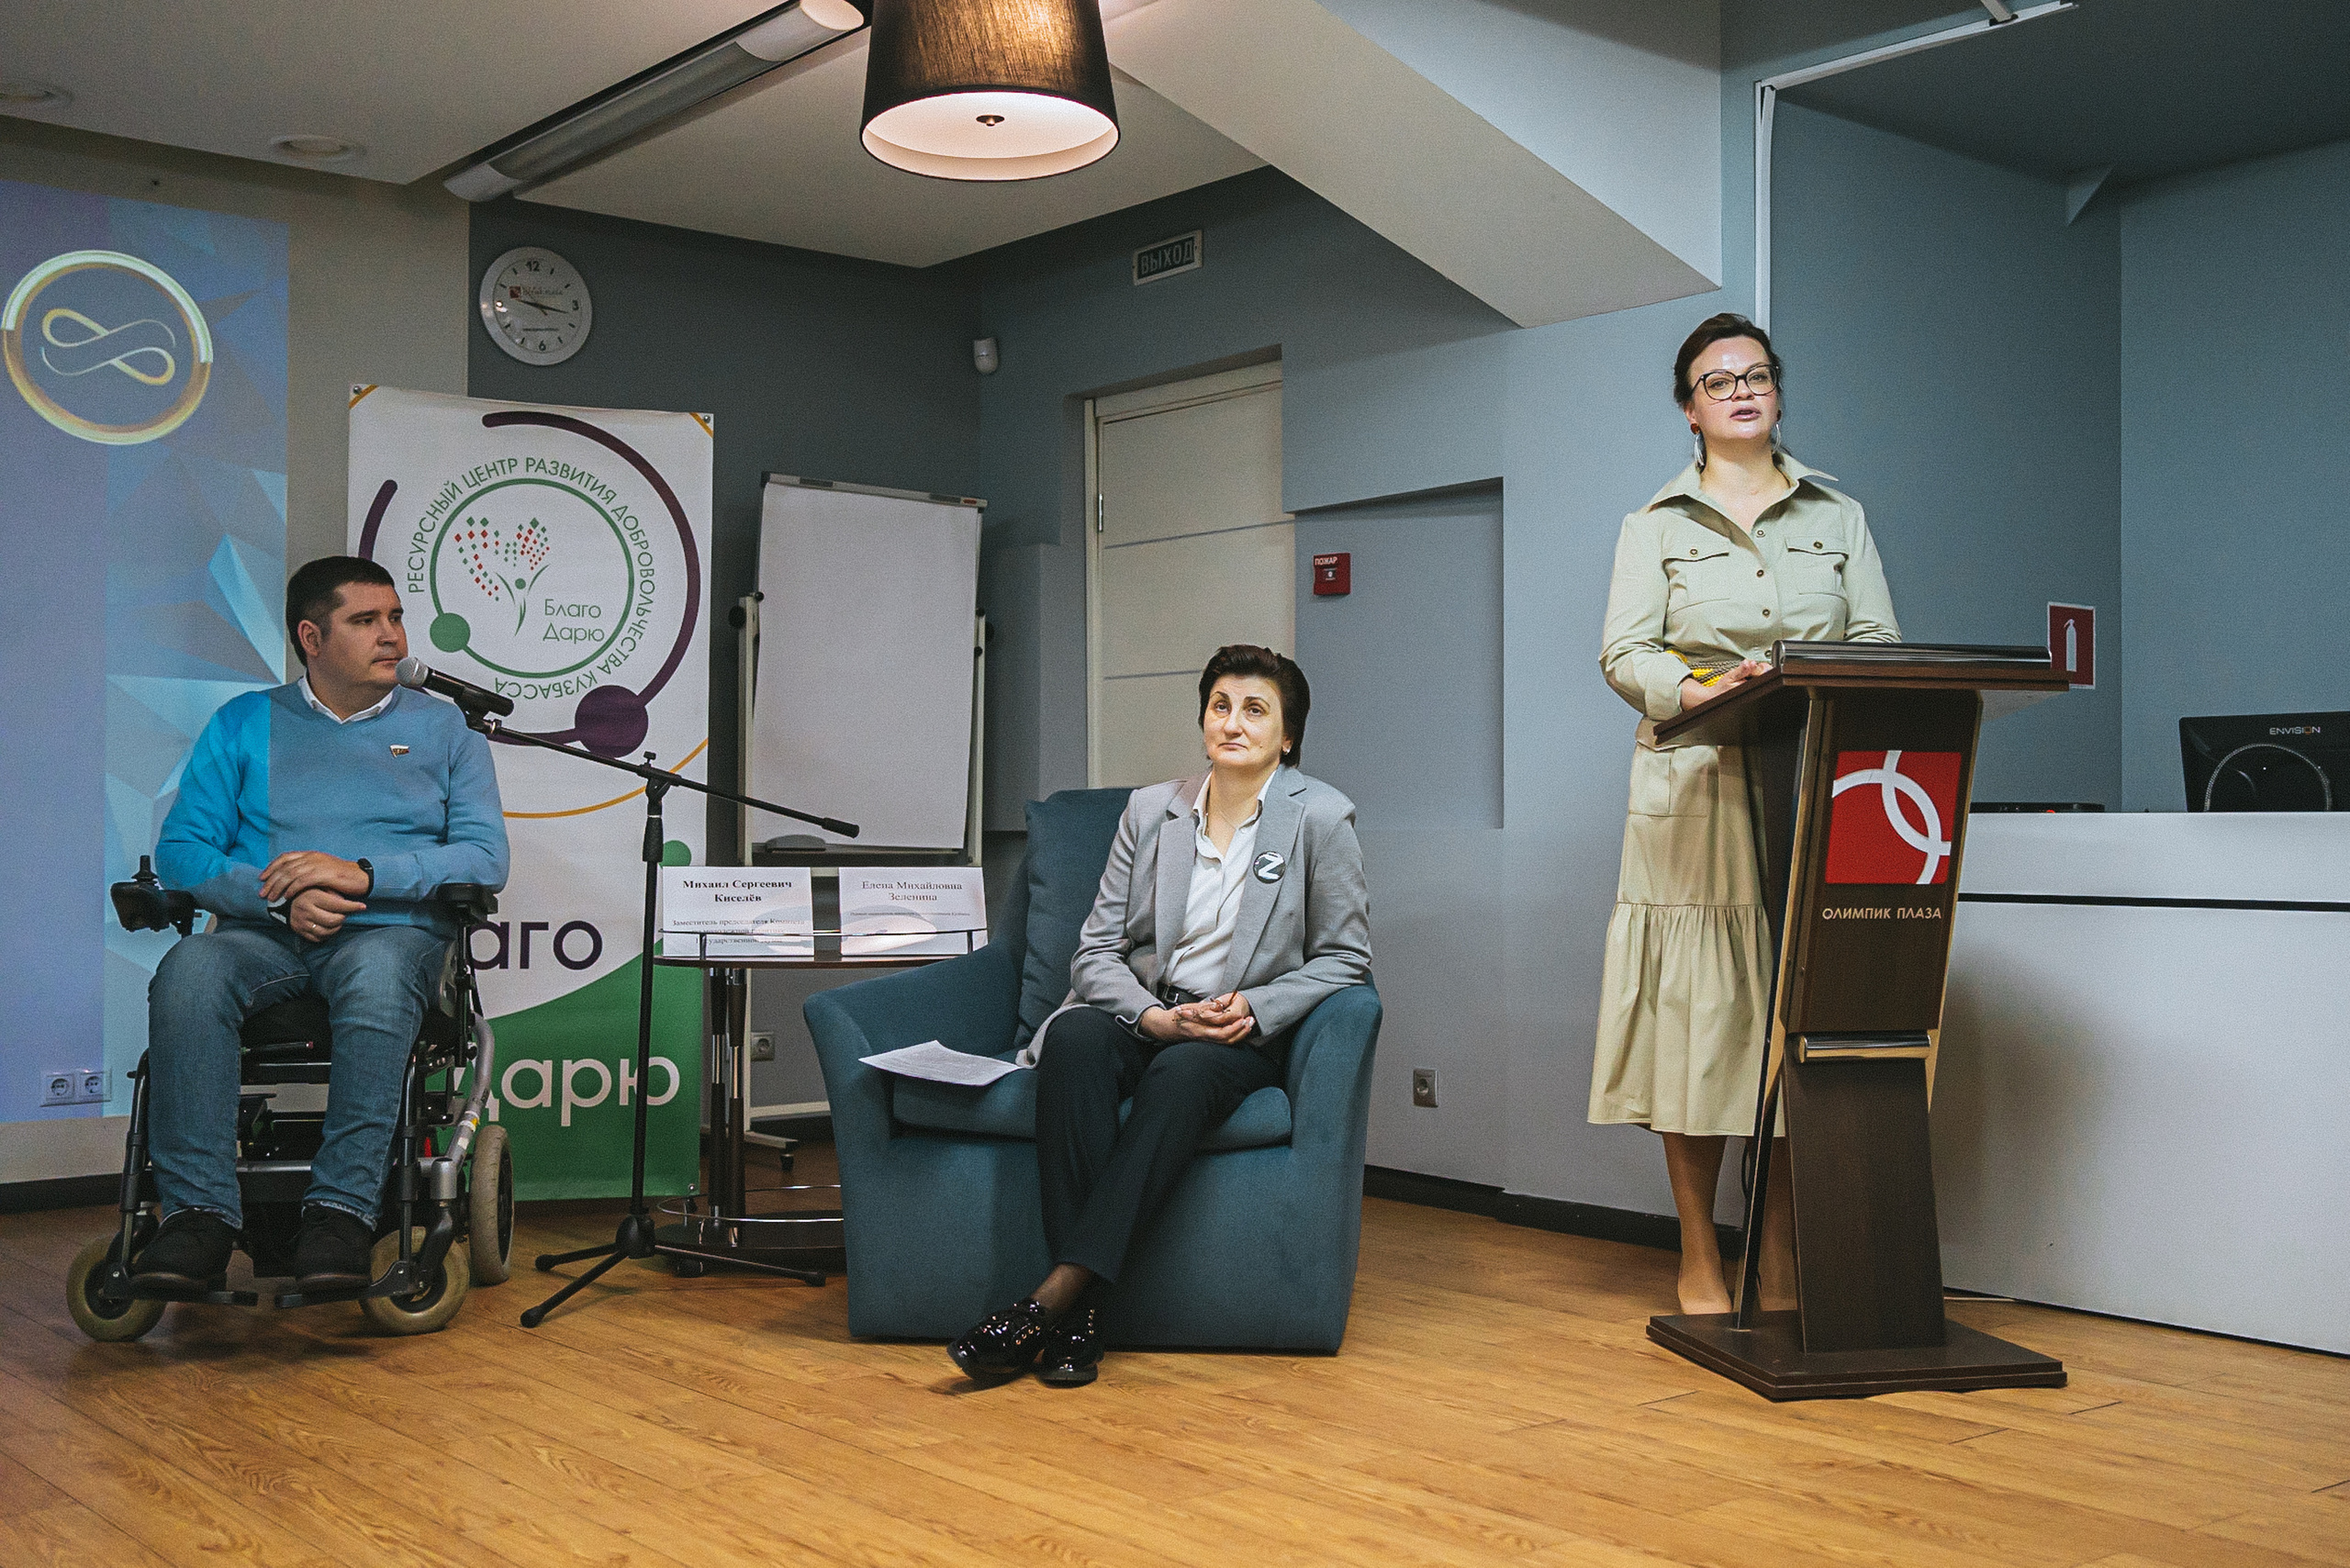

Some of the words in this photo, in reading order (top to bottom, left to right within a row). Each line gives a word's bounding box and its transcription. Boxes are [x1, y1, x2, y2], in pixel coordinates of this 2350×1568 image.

[525, 260, 540, 272] 12
[1140, 240, 1193, 274] ВЫХОД
[572, 299, 579, 310] 3
[538, 340, 546, 351] 6
[462, 457, 519, 489] ЦЕНТР
[525, 457, 618, 505] РАЗВИТИЯ
[408, 480, 464, 594] РЕСУРСНЫЙ
[1315, 556, 1338, 566] ПОЖАР
[597, 504, 656, 676] ДОБРОВОЛЬЧЕСТВА
[543, 599, 602, 620] Благо
[543, 622, 605, 644] Дарю
[495, 670, 599, 700] КУЗБАССА
[2269, 726, 2321, 735] ENVISION
[1258, 853, 1284, 880] Z
[683, 879, 729, 889] Михаил
[732, 879, 792, 890] Сергеевич
[862, 880, 893, 890] Елена
[896, 880, 963, 890] Михайловна
[714, 893, 762, 902] Киселёв
[1822, 907, 1891, 920] ОЛИМПИК
[1897, 907, 1942, 920] ПЛАЗА
[467, 919, 603, 971] аго
